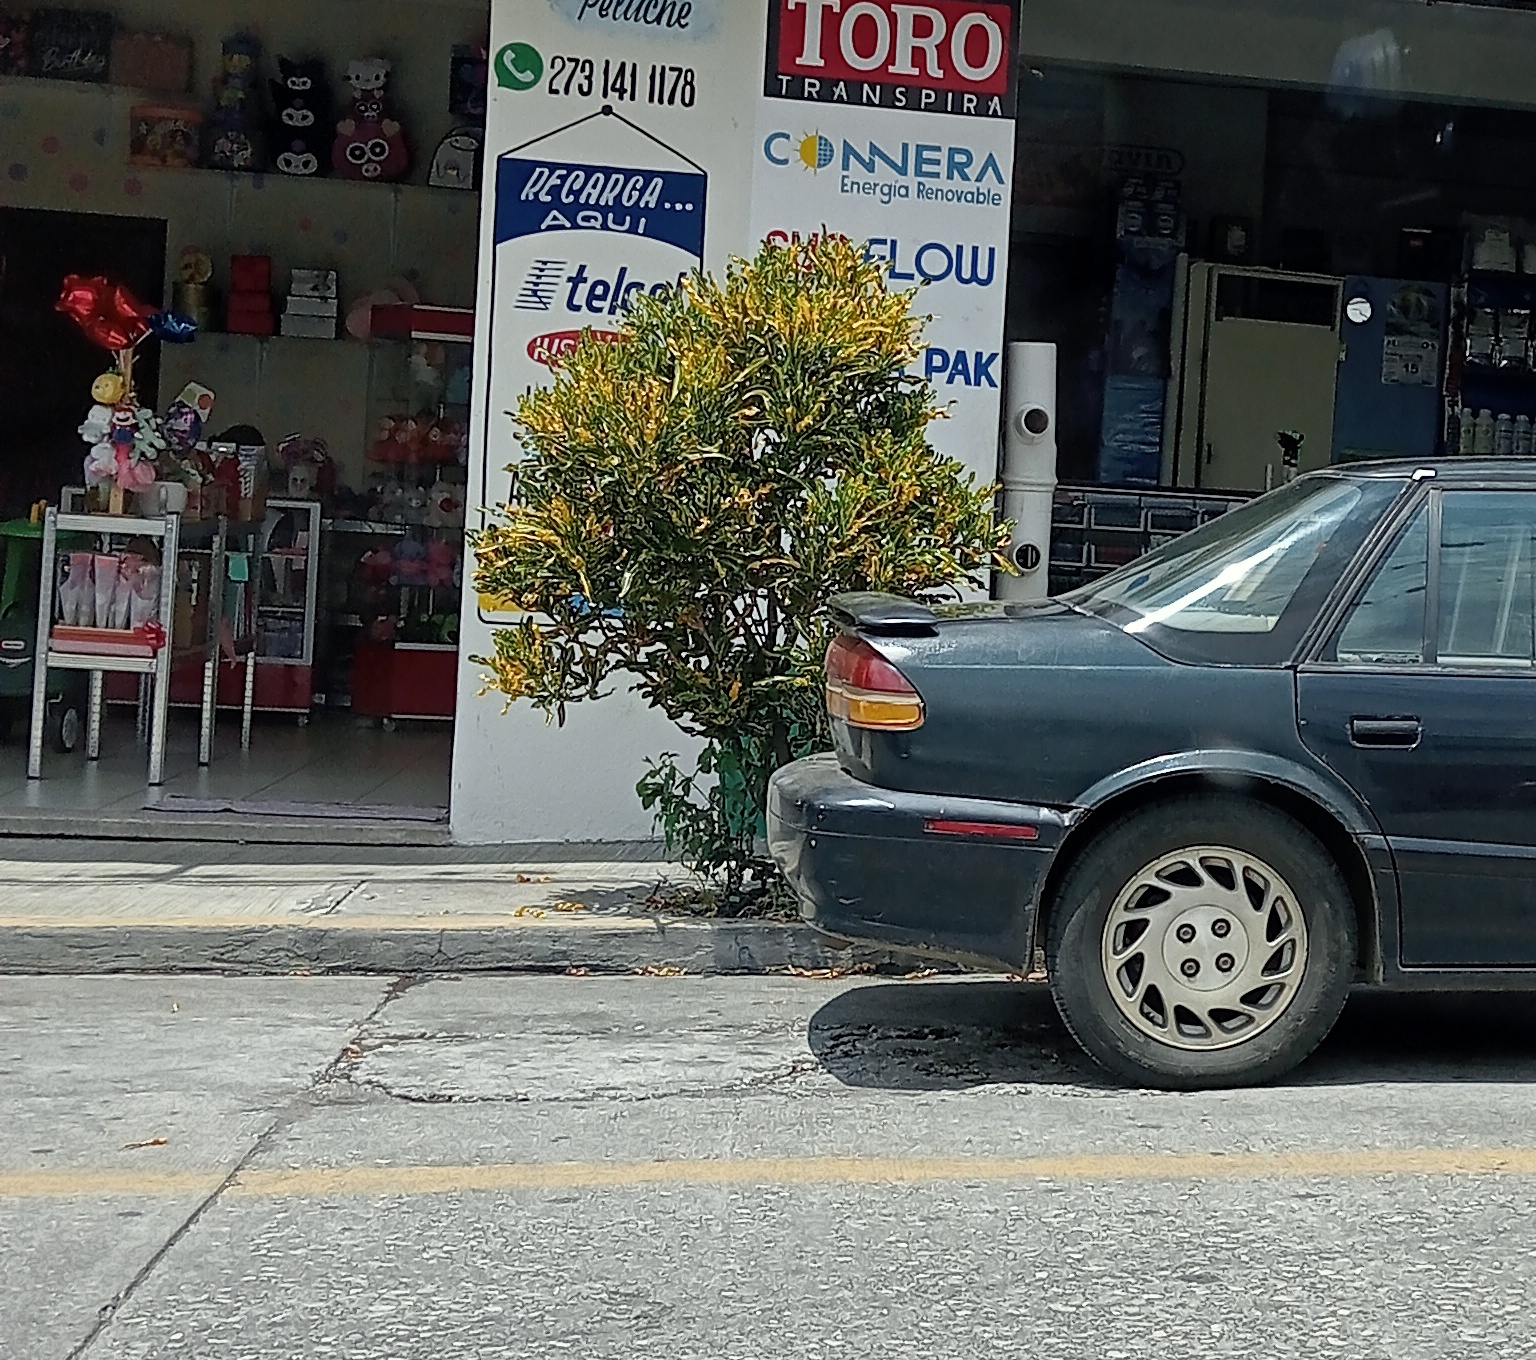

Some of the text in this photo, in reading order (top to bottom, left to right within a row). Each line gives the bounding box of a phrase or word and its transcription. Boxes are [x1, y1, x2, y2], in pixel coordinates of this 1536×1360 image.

[548, 55, 696, 108] 273 141 1178
[777, 74, 1003, 117] TRANSPIRA
[916, 180, 1003, 207] Renovable
[540, 209, 647, 234] AQUI
[566, 264, 688, 316] telc
